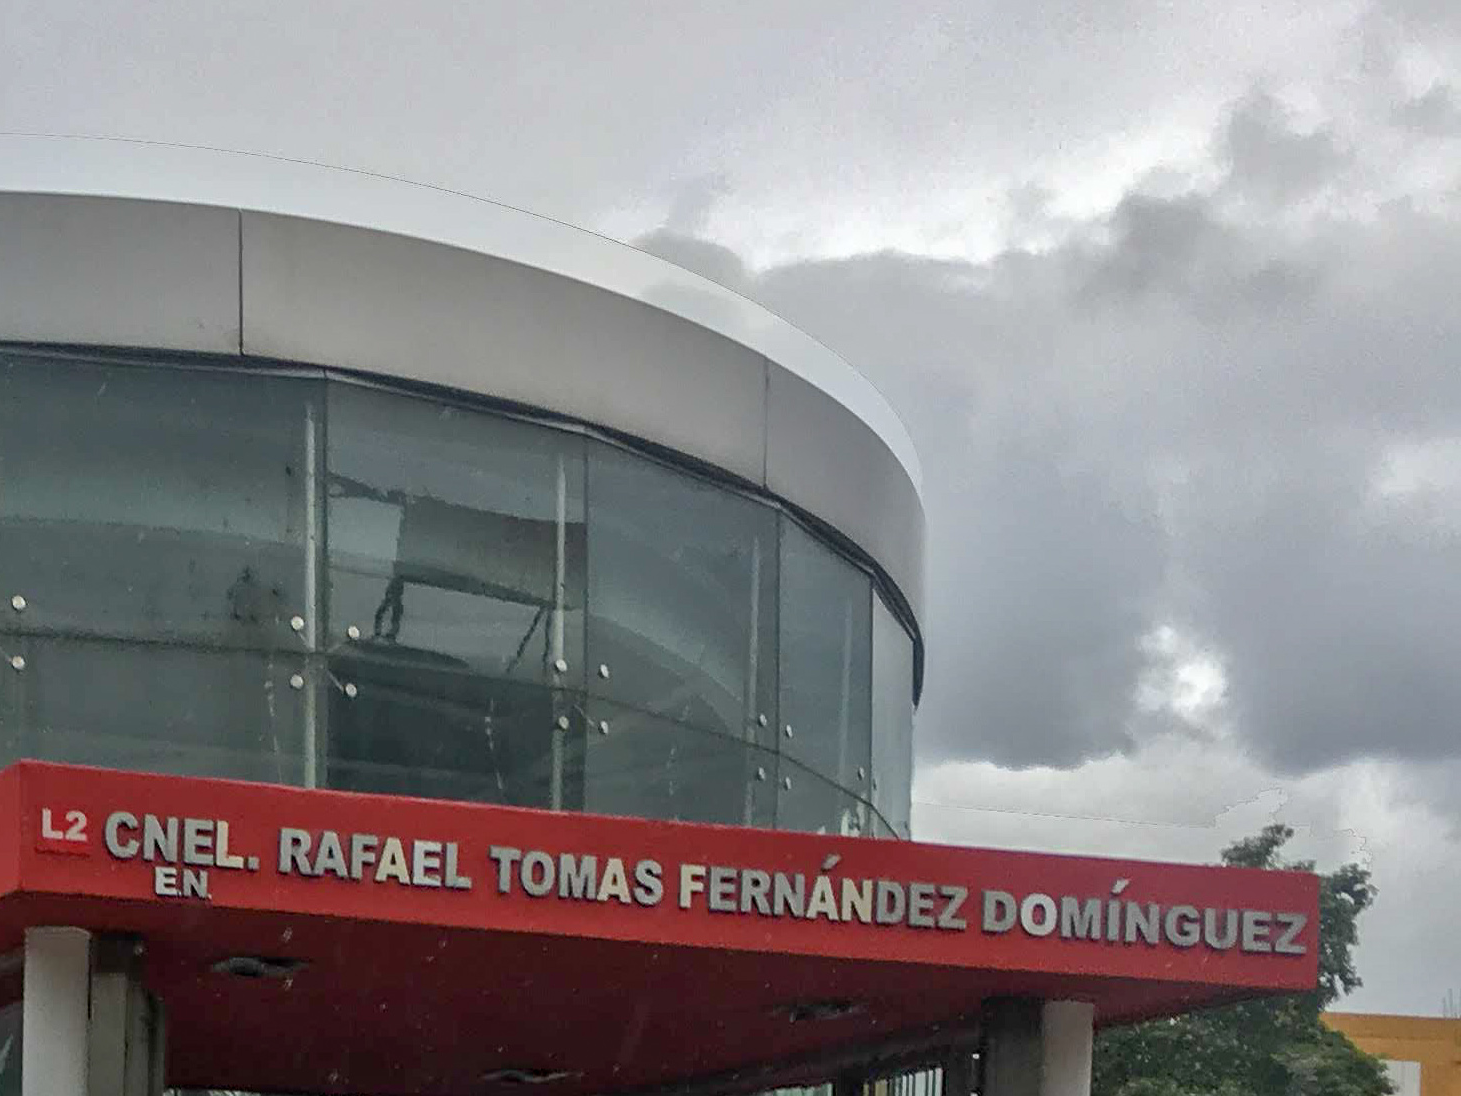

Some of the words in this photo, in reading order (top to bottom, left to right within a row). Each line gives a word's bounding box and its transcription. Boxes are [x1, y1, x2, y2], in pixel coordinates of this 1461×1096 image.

[41, 807, 88, 842] L2
[104, 811, 260, 870] CNEL.
[279, 828, 472, 890] RAFAEL
[489, 845, 664, 908] TOMAS
[679, 854, 968, 932] FERNÁNDEZ
[982, 878, 1308, 956] DOMÍNGUEZ
